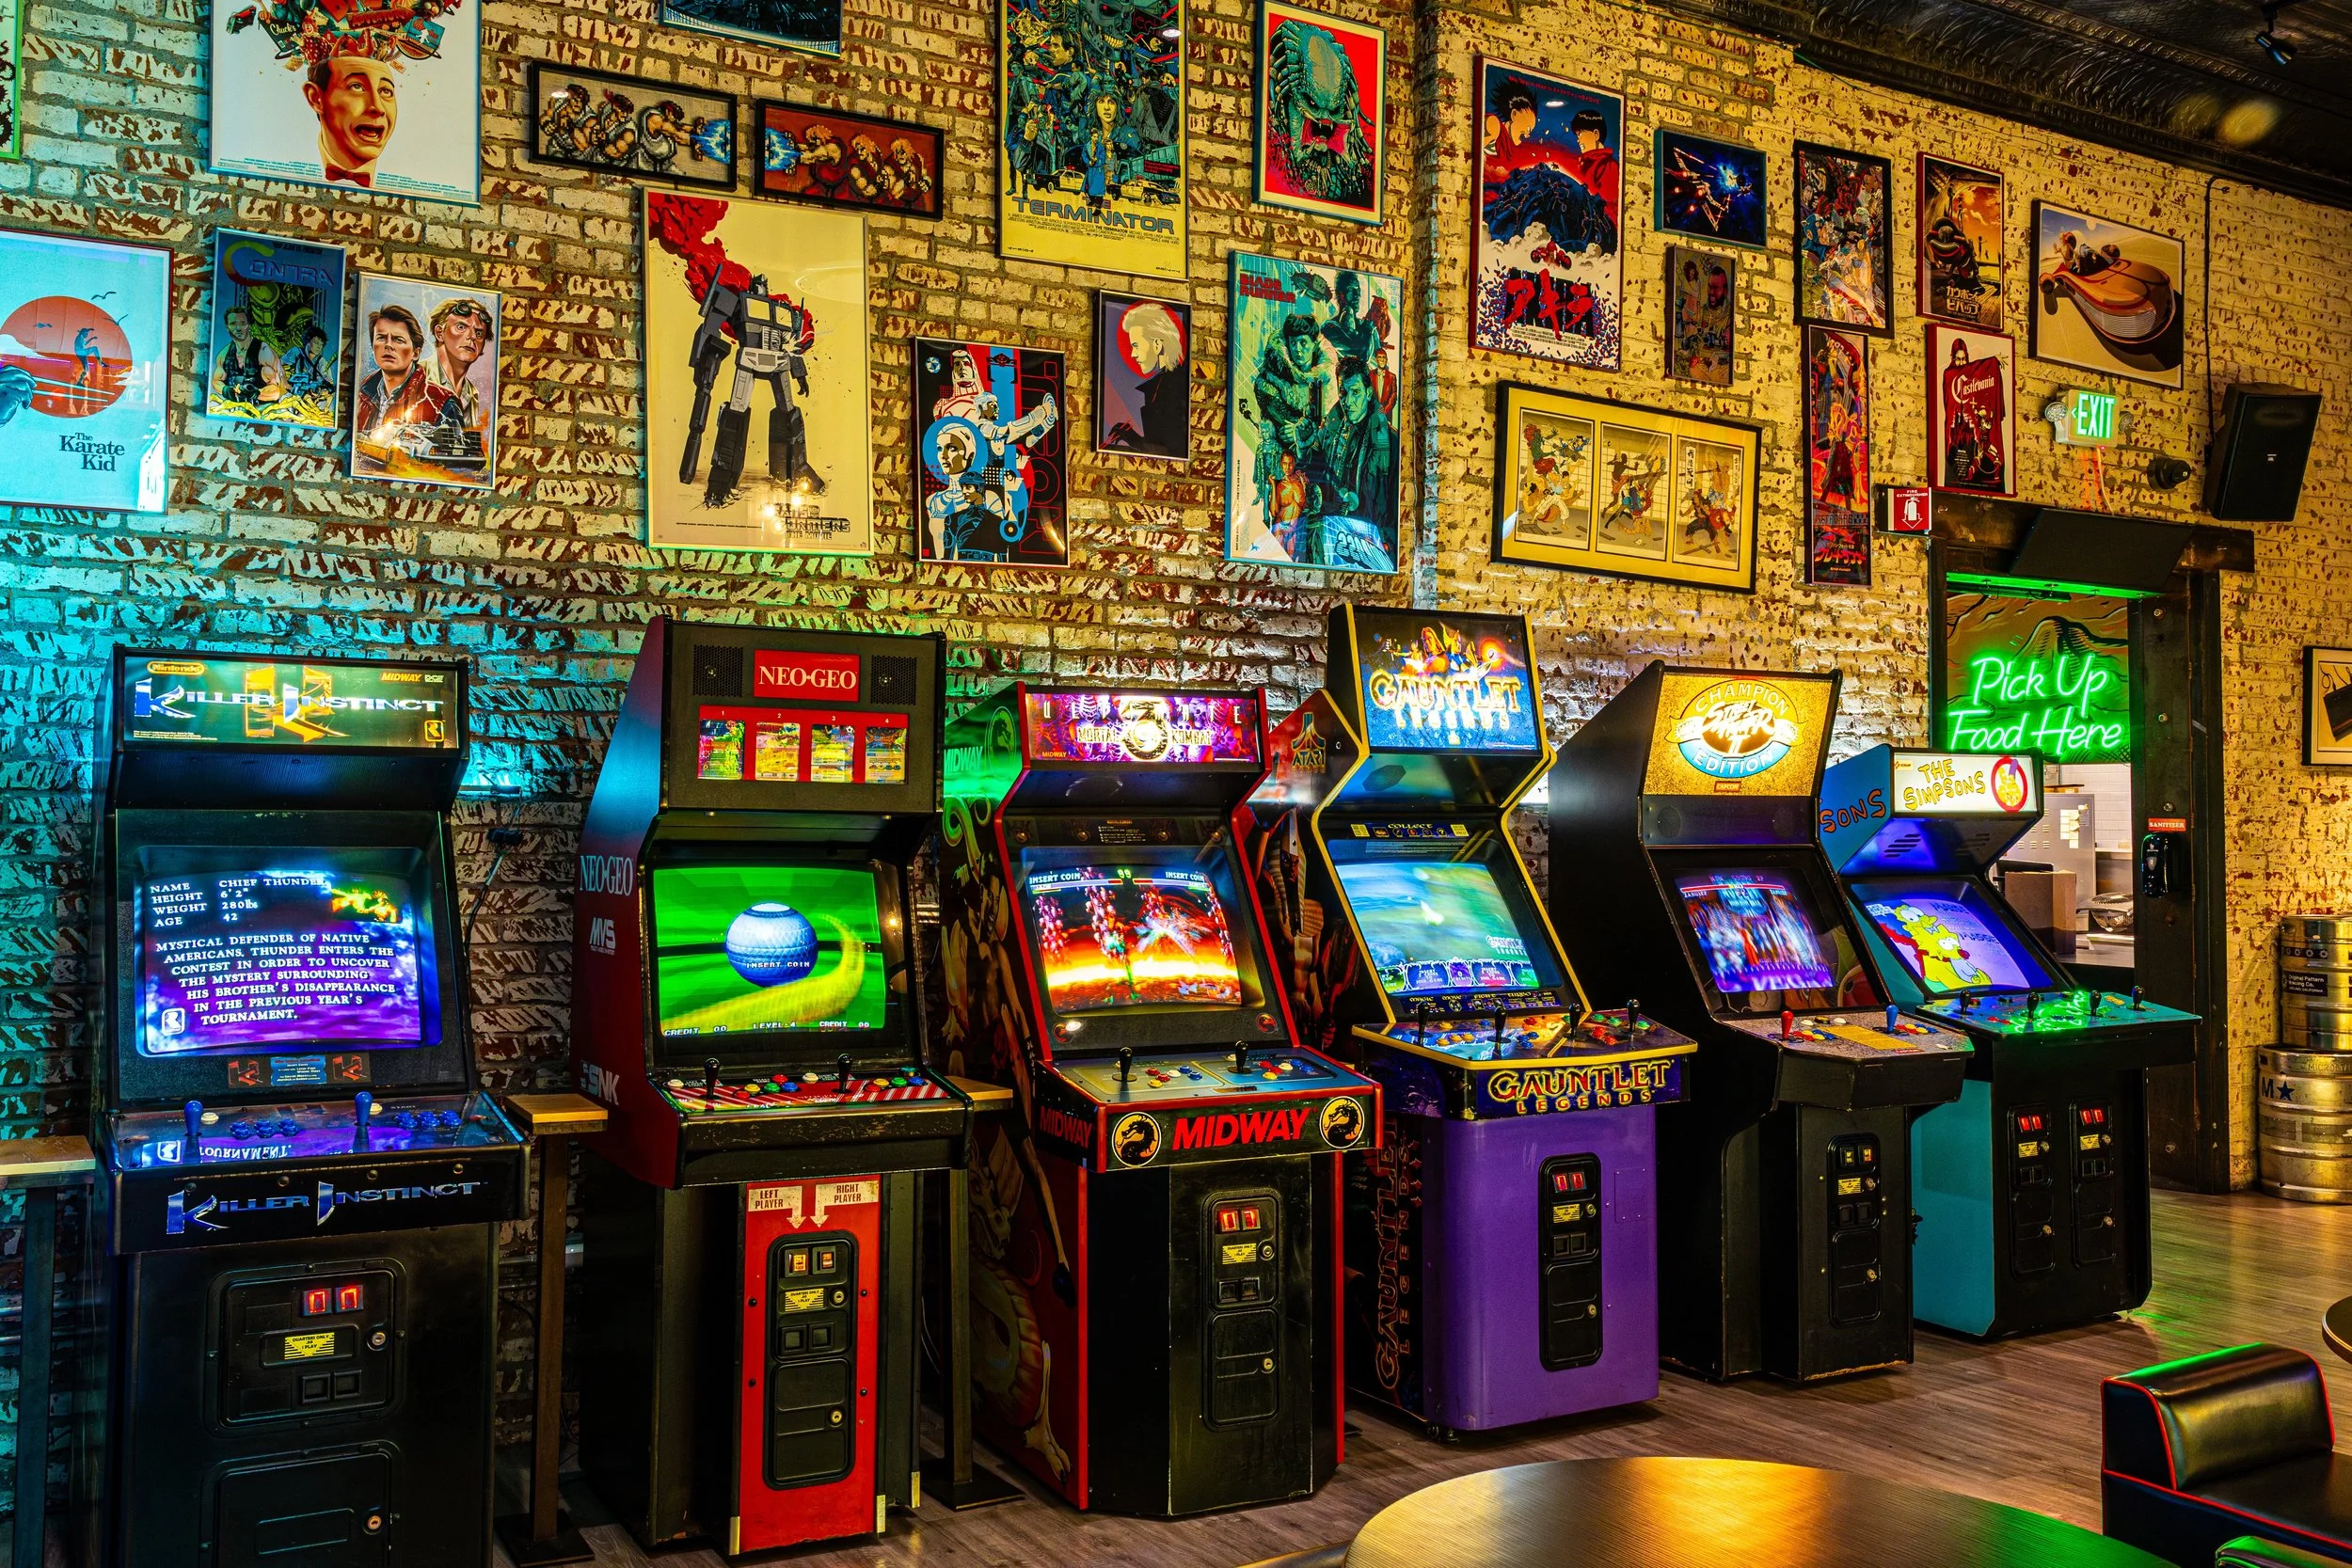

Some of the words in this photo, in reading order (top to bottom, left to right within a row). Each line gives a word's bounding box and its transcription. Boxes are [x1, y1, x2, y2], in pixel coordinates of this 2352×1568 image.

[1083, 197, 1111, 210] TE
[1011, 196, 1175, 235] TERMINATOR
[1240, 274, 1281, 290] BLADE
[1240, 285, 1295, 304] RUNNER
[1951, 374, 1994, 404] Castlevania
[2076, 392, 2116, 439] EXIT
[58, 435, 125, 456] Karate
[75, 432, 93, 441] The
[81, 453, 117, 472] Kid
[149, 663, 203, 673] Nintendo
[1370, 669, 1521, 712] GAUNTLET
[1972, 657, 2044, 705] Pick
[2057, 653, 2107, 719] Up
[134, 677, 275, 718] KILLER
[283, 683, 444, 723] INSTINCT
[1695, 683, 1789, 717] CHAMPION
[1077, 727, 1121, 743] MORTAL
[1171, 729, 1212, 745] KOMBAT
[1948, 711, 2030, 750] Food
[2031, 705, 2122, 755] Here
[944, 743, 985, 774] MIDWAY
[1292, 750, 1326, 766] ATARI
[1692, 751, 1773, 775] EDITION
[1918, 758, 1955, 784] THE
[1903, 771, 1985, 811] SIMPSONS
[1820, 789, 1885, 832] SONS
[1029, 873, 1058, 884] INSERT
[1059, 872, 1080, 882] COIN
[1118, 869, 1132, 879] 99
[1166, 871, 1188, 880] INSERT
[1189, 873, 1204, 881] COIN
[150, 882, 190, 894] NAME
[218, 879, 258, 888] CHIEF
[263, 878, 326, 887] THUNDER
[152, 892, 203, 904] HEIGHT
[153, 903, 207, 915] WEIGHT
[222, 900, 258, 910] 280lbs
[154, 916, 183, 927] AGE
[223, 912, 238, 922] 42
[590, 918, 615, 949] MVS
[156, 936, 223, 952] MYSTICAL
[230, 935, 294, 945] DEFENDER
[300, 934, 316, 943] OF
[322, 934, 370, 943] NATIVE
[164, 947, 245, 963] AMERICANS.
[250, 946, 312, 957] THUNDER
[319, 946, 364, 956] ENTERS
[369, 946, 394, 957] THE
[171, 961, 230, 975] CONTEST
[237, 959, 252, 969] IN
[259, 958, 300, 968] ORDER
[308, 958, 326, 967] TO
[331, 958, 390, 968] UNCOVER
[179, 977, 206, 988] THE
[212, 972, 270, 984] MYSTERY
[277, 970, 369, 980] SURROUNDING
[187, 990, 210, 1000] HIS
[215, 984, 290, 997] BROTHER'S
[294, 983, 395, 993] DISAPPEARANCE
[193, 1002, 209, 1013] IN
[215, 1000, 243, 1011] THE
[249, 995, 311, 1006] PREVIOUS
[318, 995, 363, 1006] YEAR'S
[200, 1008, 298, 1025] TOURNAMENT.
[664, 1028, 699, 1037] CREDIT
[580, 1062, 621, 1105] SNK
[1488, 1058, 1673, 1102] GAUNTLET
[2262, 1076, 2274, 1099] M
[1516, 1089, 1653, 1115] LEGENDS
[1040, 1106, 1092, 1148] MIDWAY
[1171, 1108, 1311, 1150] MIDWAY
[760, 1189, 779, 1199] LEFT
[836, 1183, 859, 1194] RIGHT
[167, 1189, 310, 1235] KILLER
[317, 1180, 482, 1226] INSTINCT
[755, 1199, 784, 1209] PLAYER
[834, 1194, 862, 1203] PLAYER
[1399, 1145, 1410, 1354] LEGENDS
